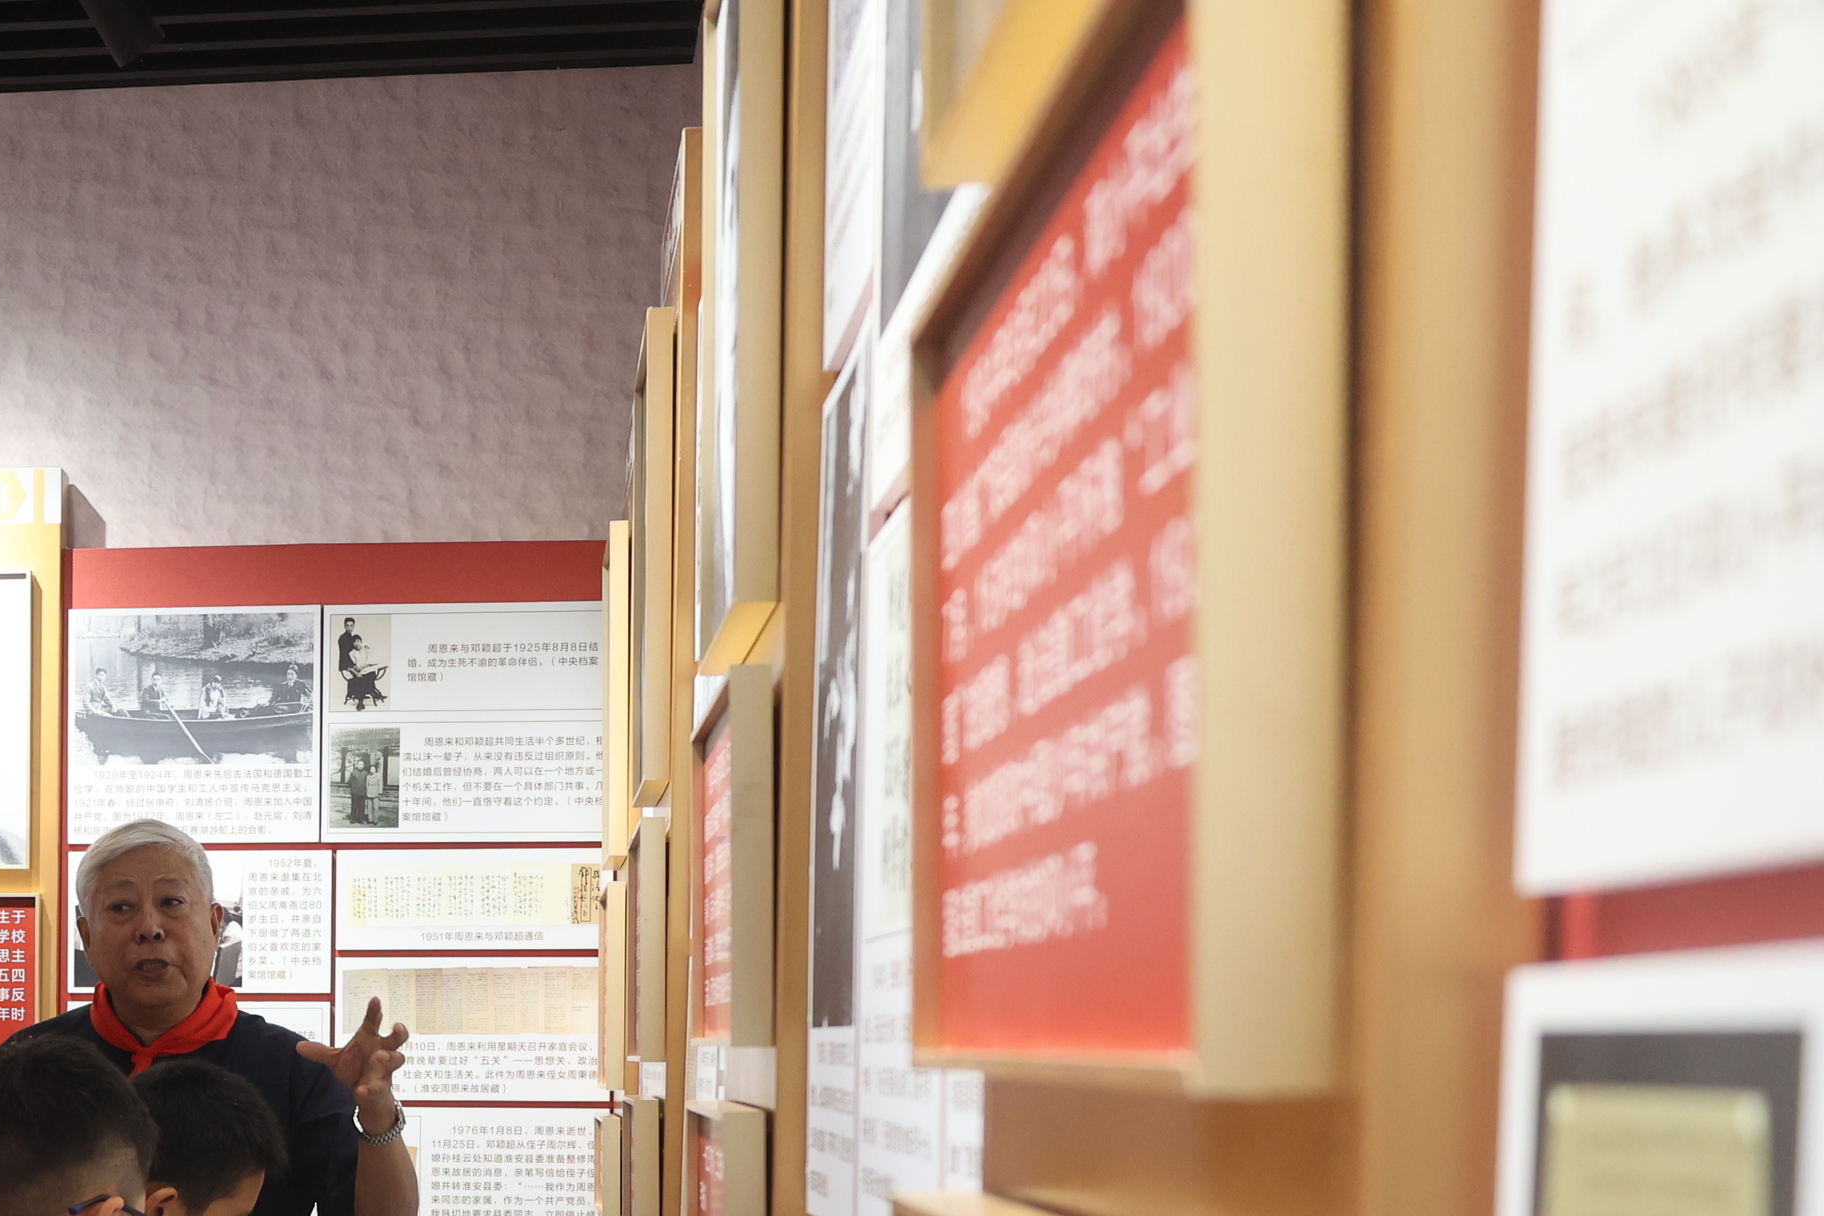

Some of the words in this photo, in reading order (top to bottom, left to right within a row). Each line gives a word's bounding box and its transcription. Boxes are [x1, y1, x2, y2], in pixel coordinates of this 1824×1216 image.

[428, 642, 599, 654] 周恩来与邓颖超于1925年8月8日结
[407, 657, 599, 668] 婚，成为生死不渝的革命伴侣。（中央档案
[407, 672, 444, 682] 馆馆藏）
[94, 769, 312, 780] 1920年至1924年，周恩来先后去法国和德国勤工
[74, 783, 309, 794] 俭学，在旅欧的中国学生和工人中宣传马克思主义。
[74, 796, 312, 808] 1921年春，经过张申府、刘清扬介绍，周恩来加入中国
[402, 812, 448, 822] 案馆馆藏）
[268, 859, 317, 868] 1952年夏，
[248, 873, 322, 882] 周恩来邀集在北
[248, 887, 322, 896] 京的亲戚，为六
[248, 901, 322, 910] 伯父周嵩尧过80
[248, 915, 322, 924] 岁生日，并亲自
[248, 929, 322, 938] 下厨做了两道六
[420, 931, 544, 942] 1951年周恩来与邓颖超通信
[248, 942, 322, 951] 伯父喜欢吃的家
[248, 956, 322, 966] 乡菜。（中央档
[248, 970, 293, 979] 案馆馆藏）
[452, 1125, 593, 1136] 1976年1月8日，周恩来逝世。
[431, 1139, 595, 1150] 11月25日，邓颖超从侄子周尔辉、侄
[431, 1153, 595, 1164] 媳孙桂云处知道淮安县委准备整修周
[431, 1167, 595, 1178] 恩来故居的消息，亲笔写信给侄子侄
[431, 1195, 591, 1206] 来同志的家属，作为一个共产党员，
